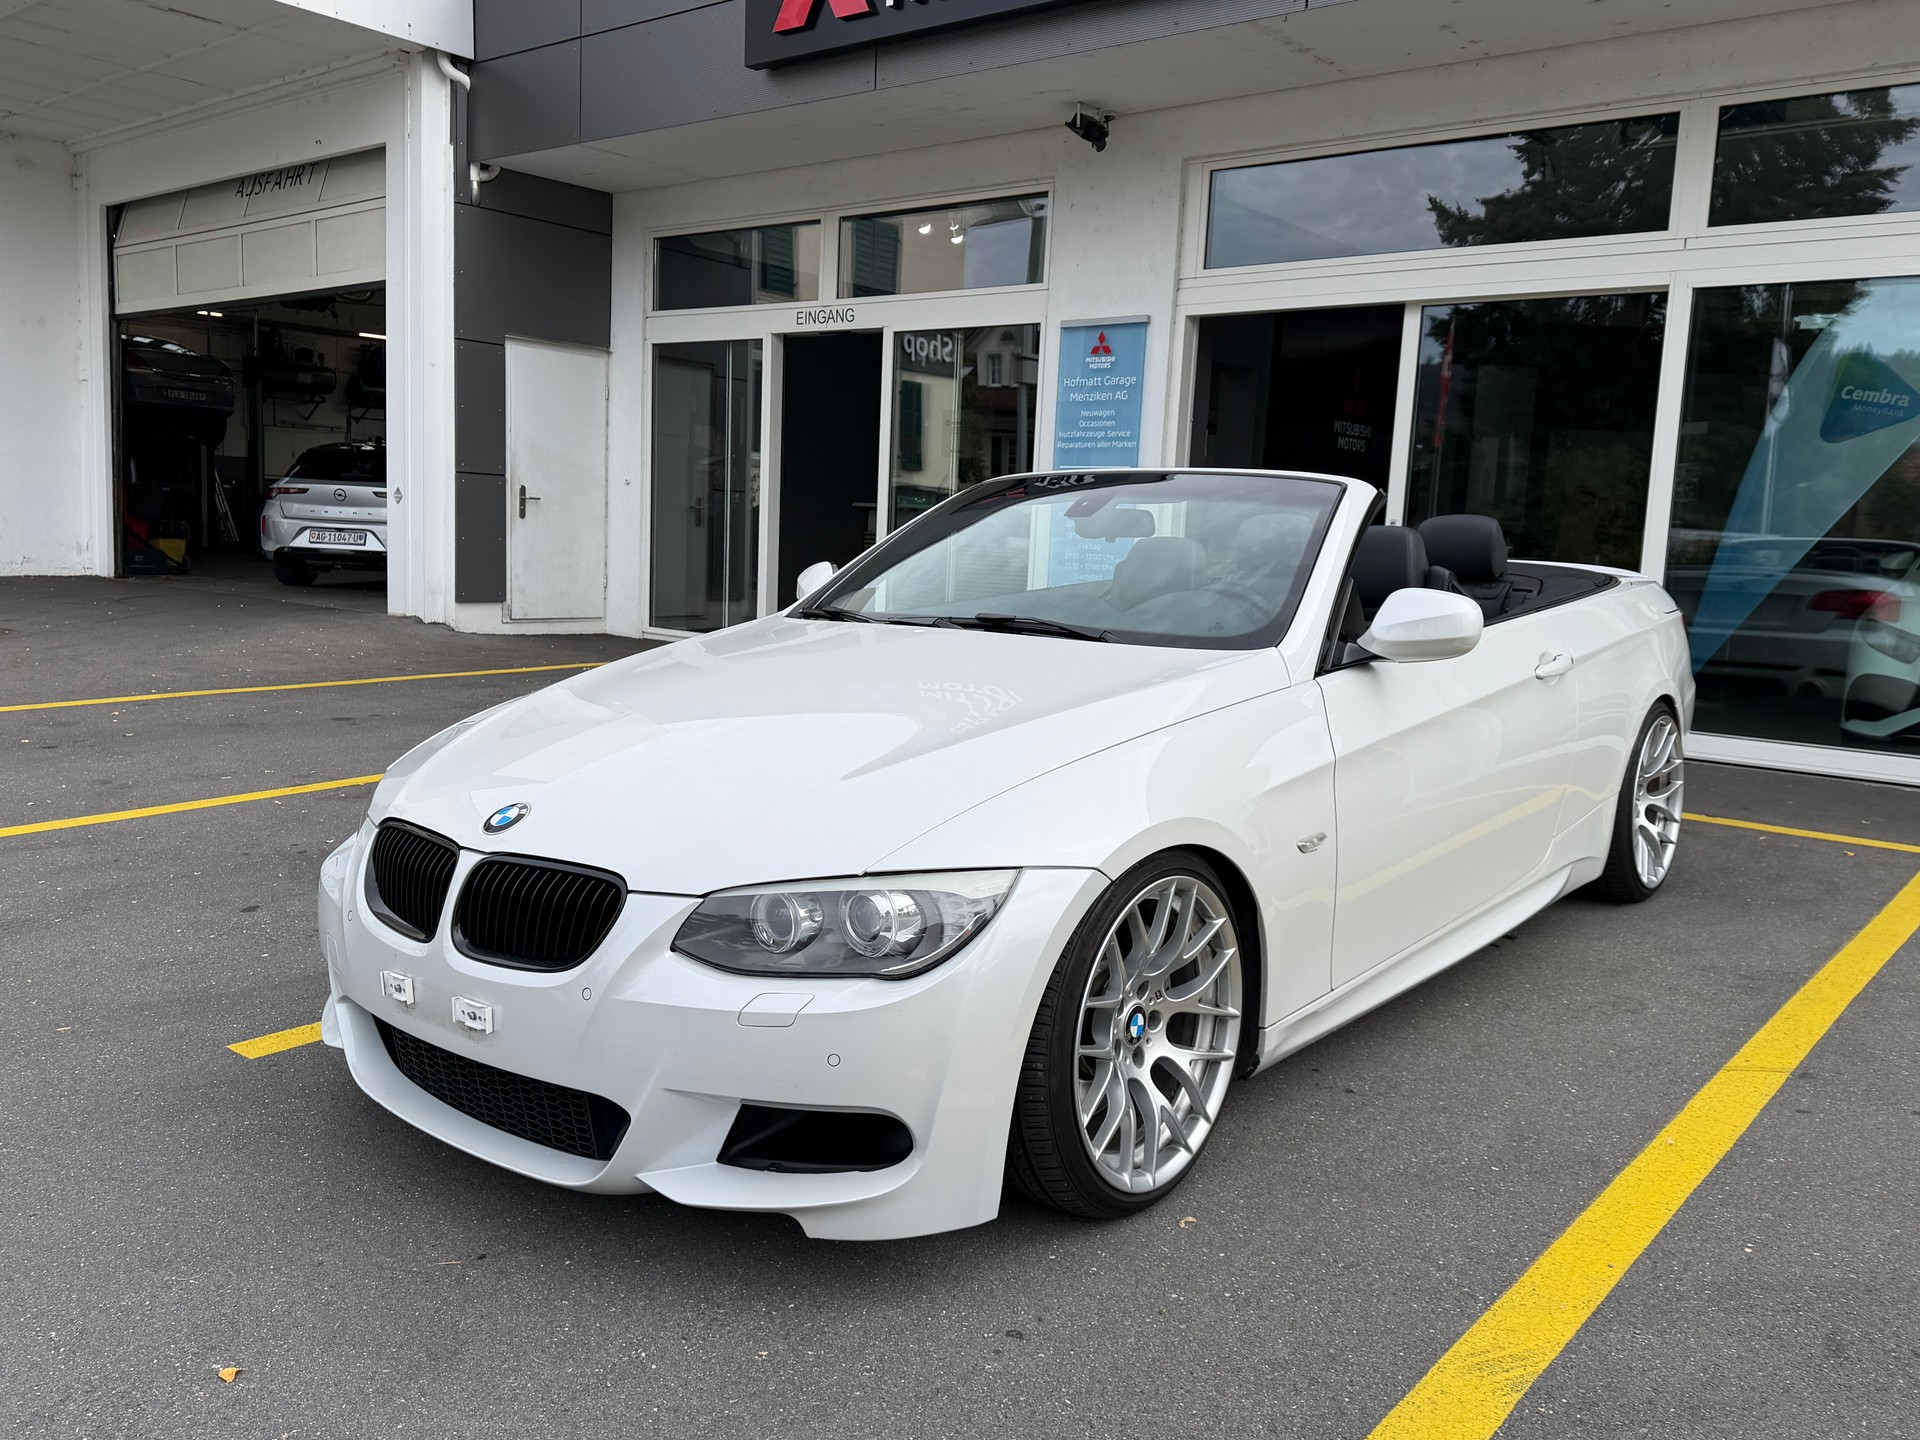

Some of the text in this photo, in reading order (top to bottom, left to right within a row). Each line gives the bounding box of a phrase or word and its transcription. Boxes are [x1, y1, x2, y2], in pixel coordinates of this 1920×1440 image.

[234, 162, 320, 199] AUSFAHRT
[796, 308, 855, 325] EINGANG
[1063, 375, 1137, 387] Hofmatt Garage
[1070, 390, 1128, 402] Menziken AG
[1841, 385, 1911, 407] Cembra
[1081, 409, 1115, 418] Neuwagen
[1852, 403, 1905, 417] MoneyBank
[1079, 419, 1116, 428] Occasionen
[1333, 419, 1373, 438] MITSUBISHI
[1058, 429, 1131, 439] Nutzfahrzeuge Service
[1057, 441, 1096, 449] Reparaturen
[1112, 440, 1137, 448] Marken
[1337, 436, 1366, 453] MOTORS
